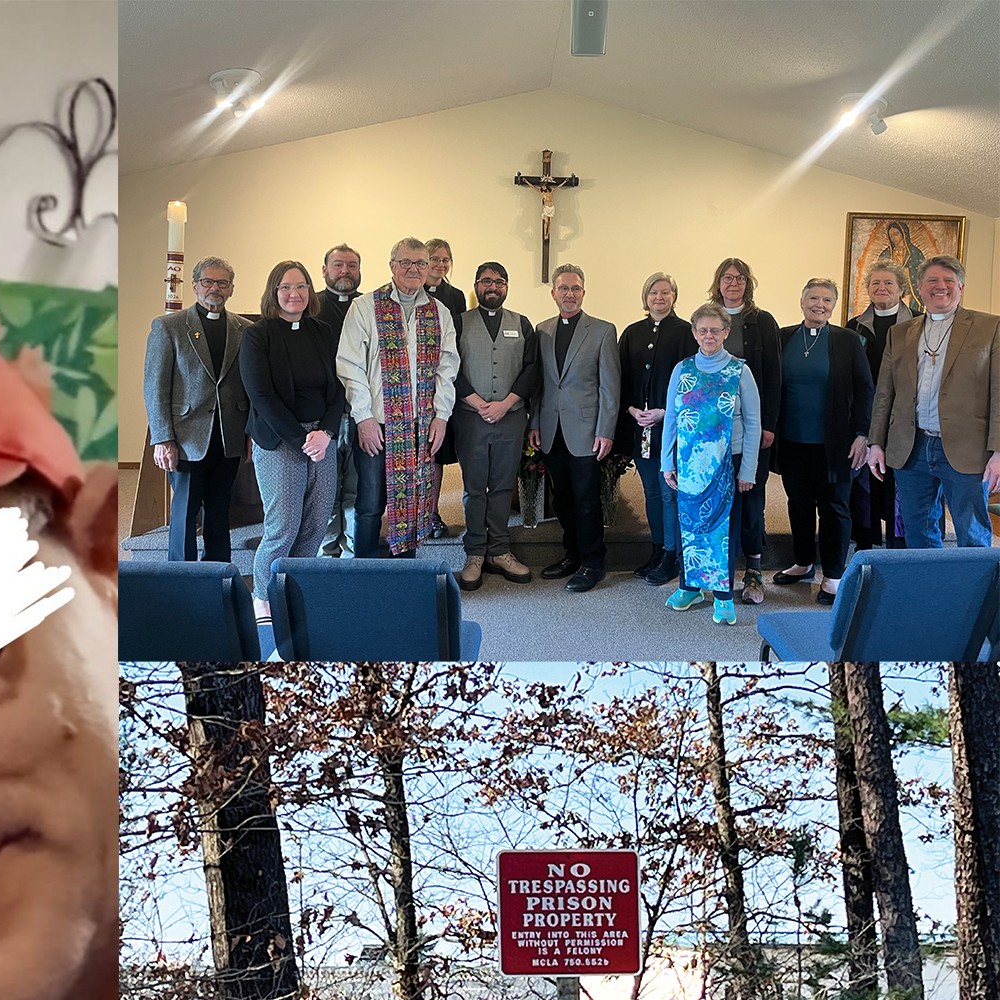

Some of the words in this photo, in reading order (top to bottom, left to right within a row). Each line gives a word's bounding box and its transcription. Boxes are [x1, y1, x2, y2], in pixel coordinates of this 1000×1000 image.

[548, 863, 591, 877] NO
[508, 879, 630, 894] TRESPASSING
[526, 896, 612, 911] PRISON
[523, 913, 617, 927] PROPERTY
[512, 931, 541, 939] ENTRY
[548, 931, 569, 939] INTO
[518, 939, 558, 947] WITHOUT
[565, 939, 623, 947] PERMISSION
[538, 947, 548, 955] IS
[554, 947, 560, 955] A
[566, 947, 602, 955] FELONY
[532, 958, 558, 966] MCLA
